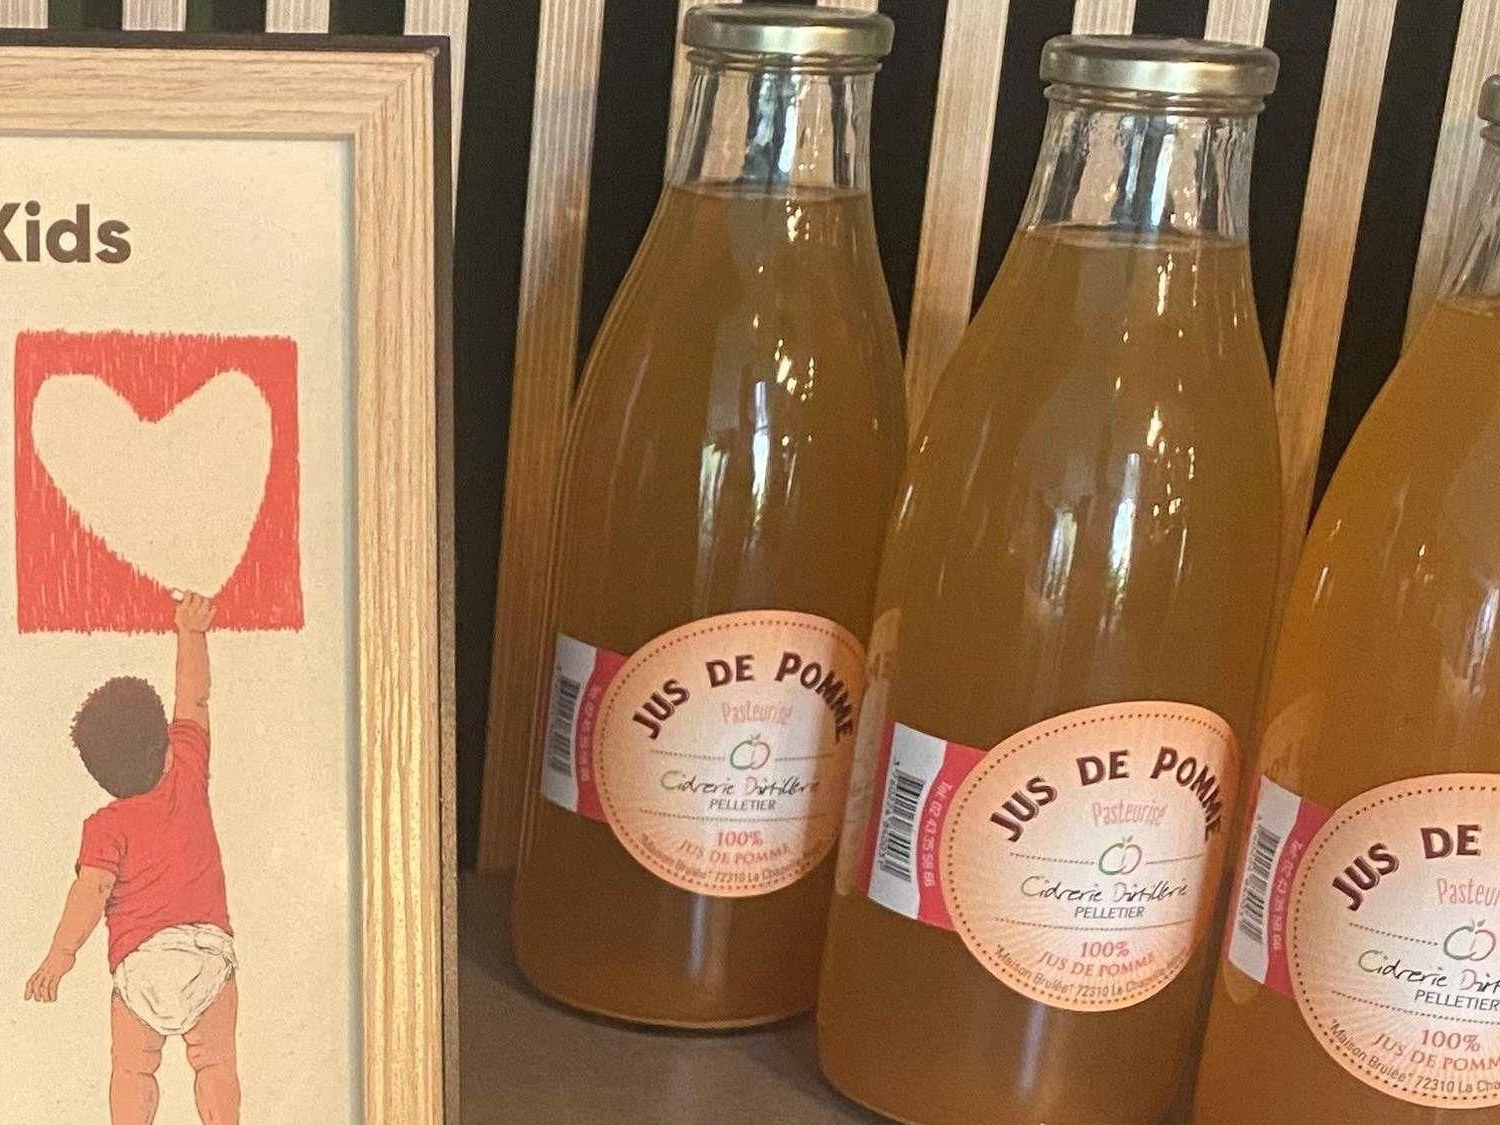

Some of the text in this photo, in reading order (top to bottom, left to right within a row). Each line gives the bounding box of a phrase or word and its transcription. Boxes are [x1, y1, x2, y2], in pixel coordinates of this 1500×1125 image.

[632, 678, 691, 741] JUS
[706, 654, 755, 688] DE
[774, 651, 854, 745] POMME
[709, 798, 777, 811] PELLETIER
[989, 745, 1223, 843] JUS DE POMME
[717, 830, 764, 847] 100%
[709, 850, 730, 864] DE
[734, 843, 791, 866] POMME
[1332, 823, 1483, 912] JUS DE
[1020, 874, 1103, 902] Cidrerie
[1074, 905, 1145, 920] PELLETIER
[1079, 940, 1130, 958] 100%
[1038, 951, 1068, 971] JUS
[1071, 961, 1095, 977] DE
[1099, 952, 1156, 977] POMME
[1357, 949, 1449, 988] Cidrerie
[1414, 988, 1500, 1012] PELLETIER
[1373, 1033, 1408, 1057] JUS
[1410, 1049, 1438, 1068] DE
[1421, 1029, 1481, 1053] 100%
[1414, 1074, 1455, 1093] 72310
